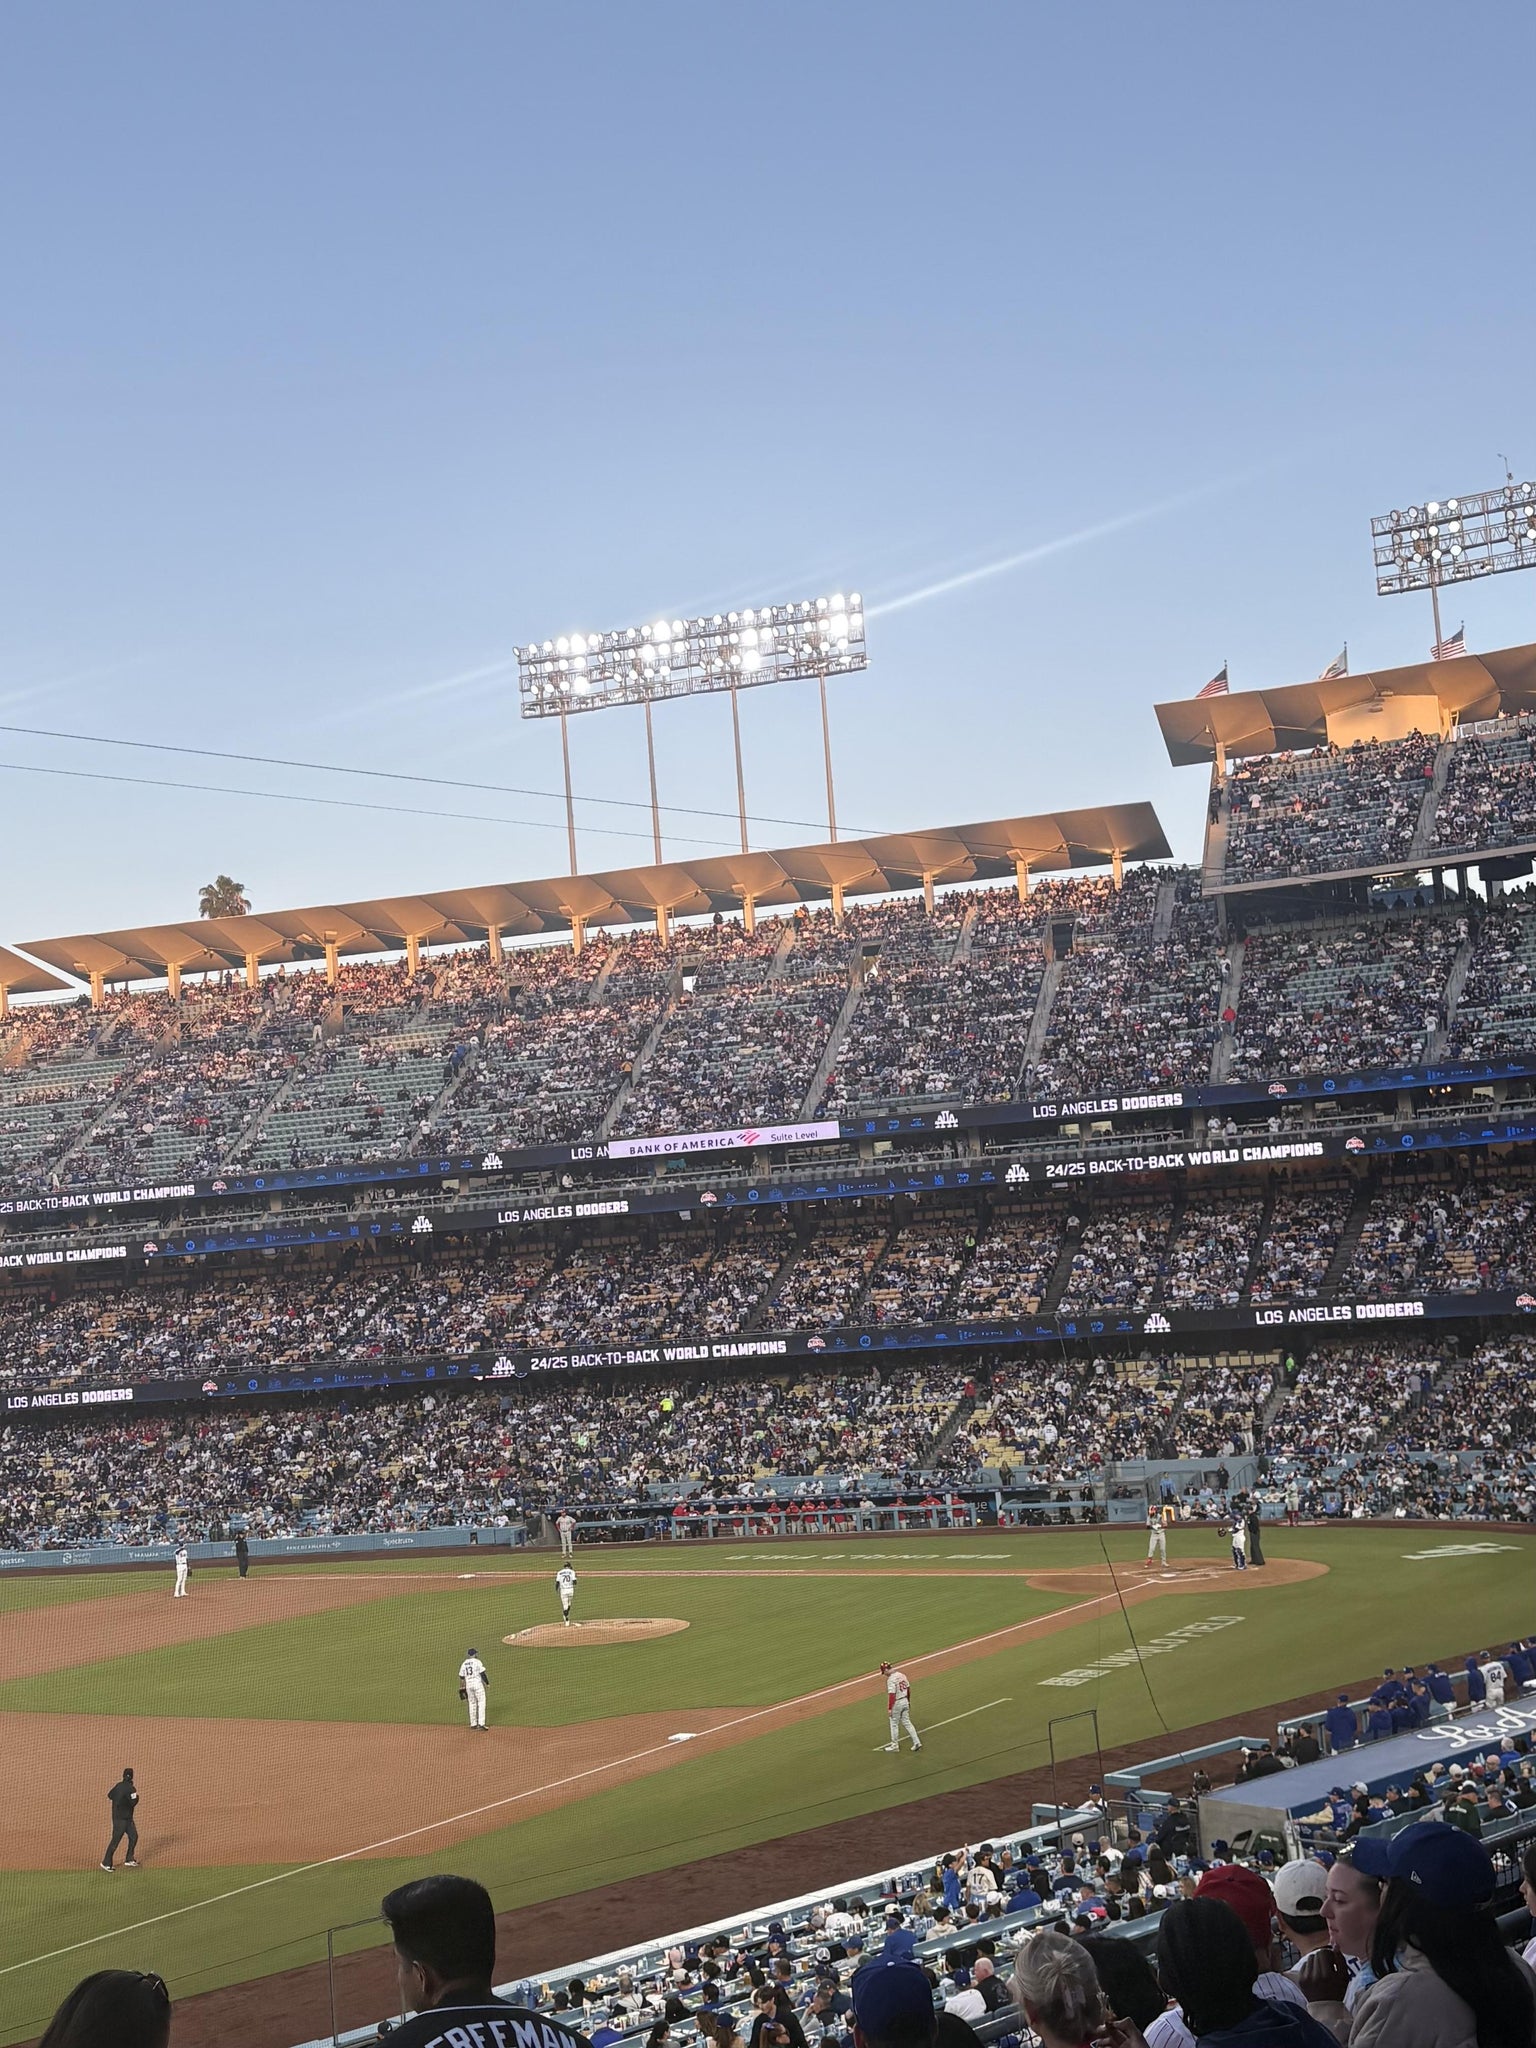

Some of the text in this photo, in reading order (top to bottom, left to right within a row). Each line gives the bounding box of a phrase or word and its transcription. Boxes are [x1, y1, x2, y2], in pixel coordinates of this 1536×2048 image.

[1032, 1092, 1183, 1119] LOS ANGELES DODGERS
[629, 1137, 734, 1155] BANK OF AMERICA
[770, 1130, 818, 1142] Suite Level
[571, 1147, 593, 1160] LOS
[1046, 1163, 1086, 1178] 24/25
[1089, 1153, 1184, 1174] BACK-TO-BACK
[1188, 1149, 1240, 1165] WORLD
[1243, 1142, 1324, 1162] CHAMPIONS
[16, 1194, 91, 1212] BACK-TO-BACK
[93, 1189, 131, 1204] WORLD
[133, 1184, 196, 1201] CHAMPIONS
[498, 1200, 629, 1224] LOS ANGELES DODGERS
[26, 1251, 64, 1266] WORLD
[66, 1245, 127, 1262] CHAMPIONS
[1255, 1301, 1425, 1325] LOS ANGELES DODGERS
[530, 1356, 568, 1371] 24/25
[571, 1349, 660, 1368] BACK-TO-BACK
[663, 1345, 709, 1361] WORLD
[712, 1340, 787, 1358] CHAMPIONS
[7, 1387, 134, 1409] LOS ANGELES DODGERS
[1165, 1615, 1246, 1638] FIELD
[465, 1666, 473, 1676] 13
[1490, 1670, 1502, 1683] 84
[1417, 1725, 1508, 1748] Los
[973, 1873, 985, 1885] 17
